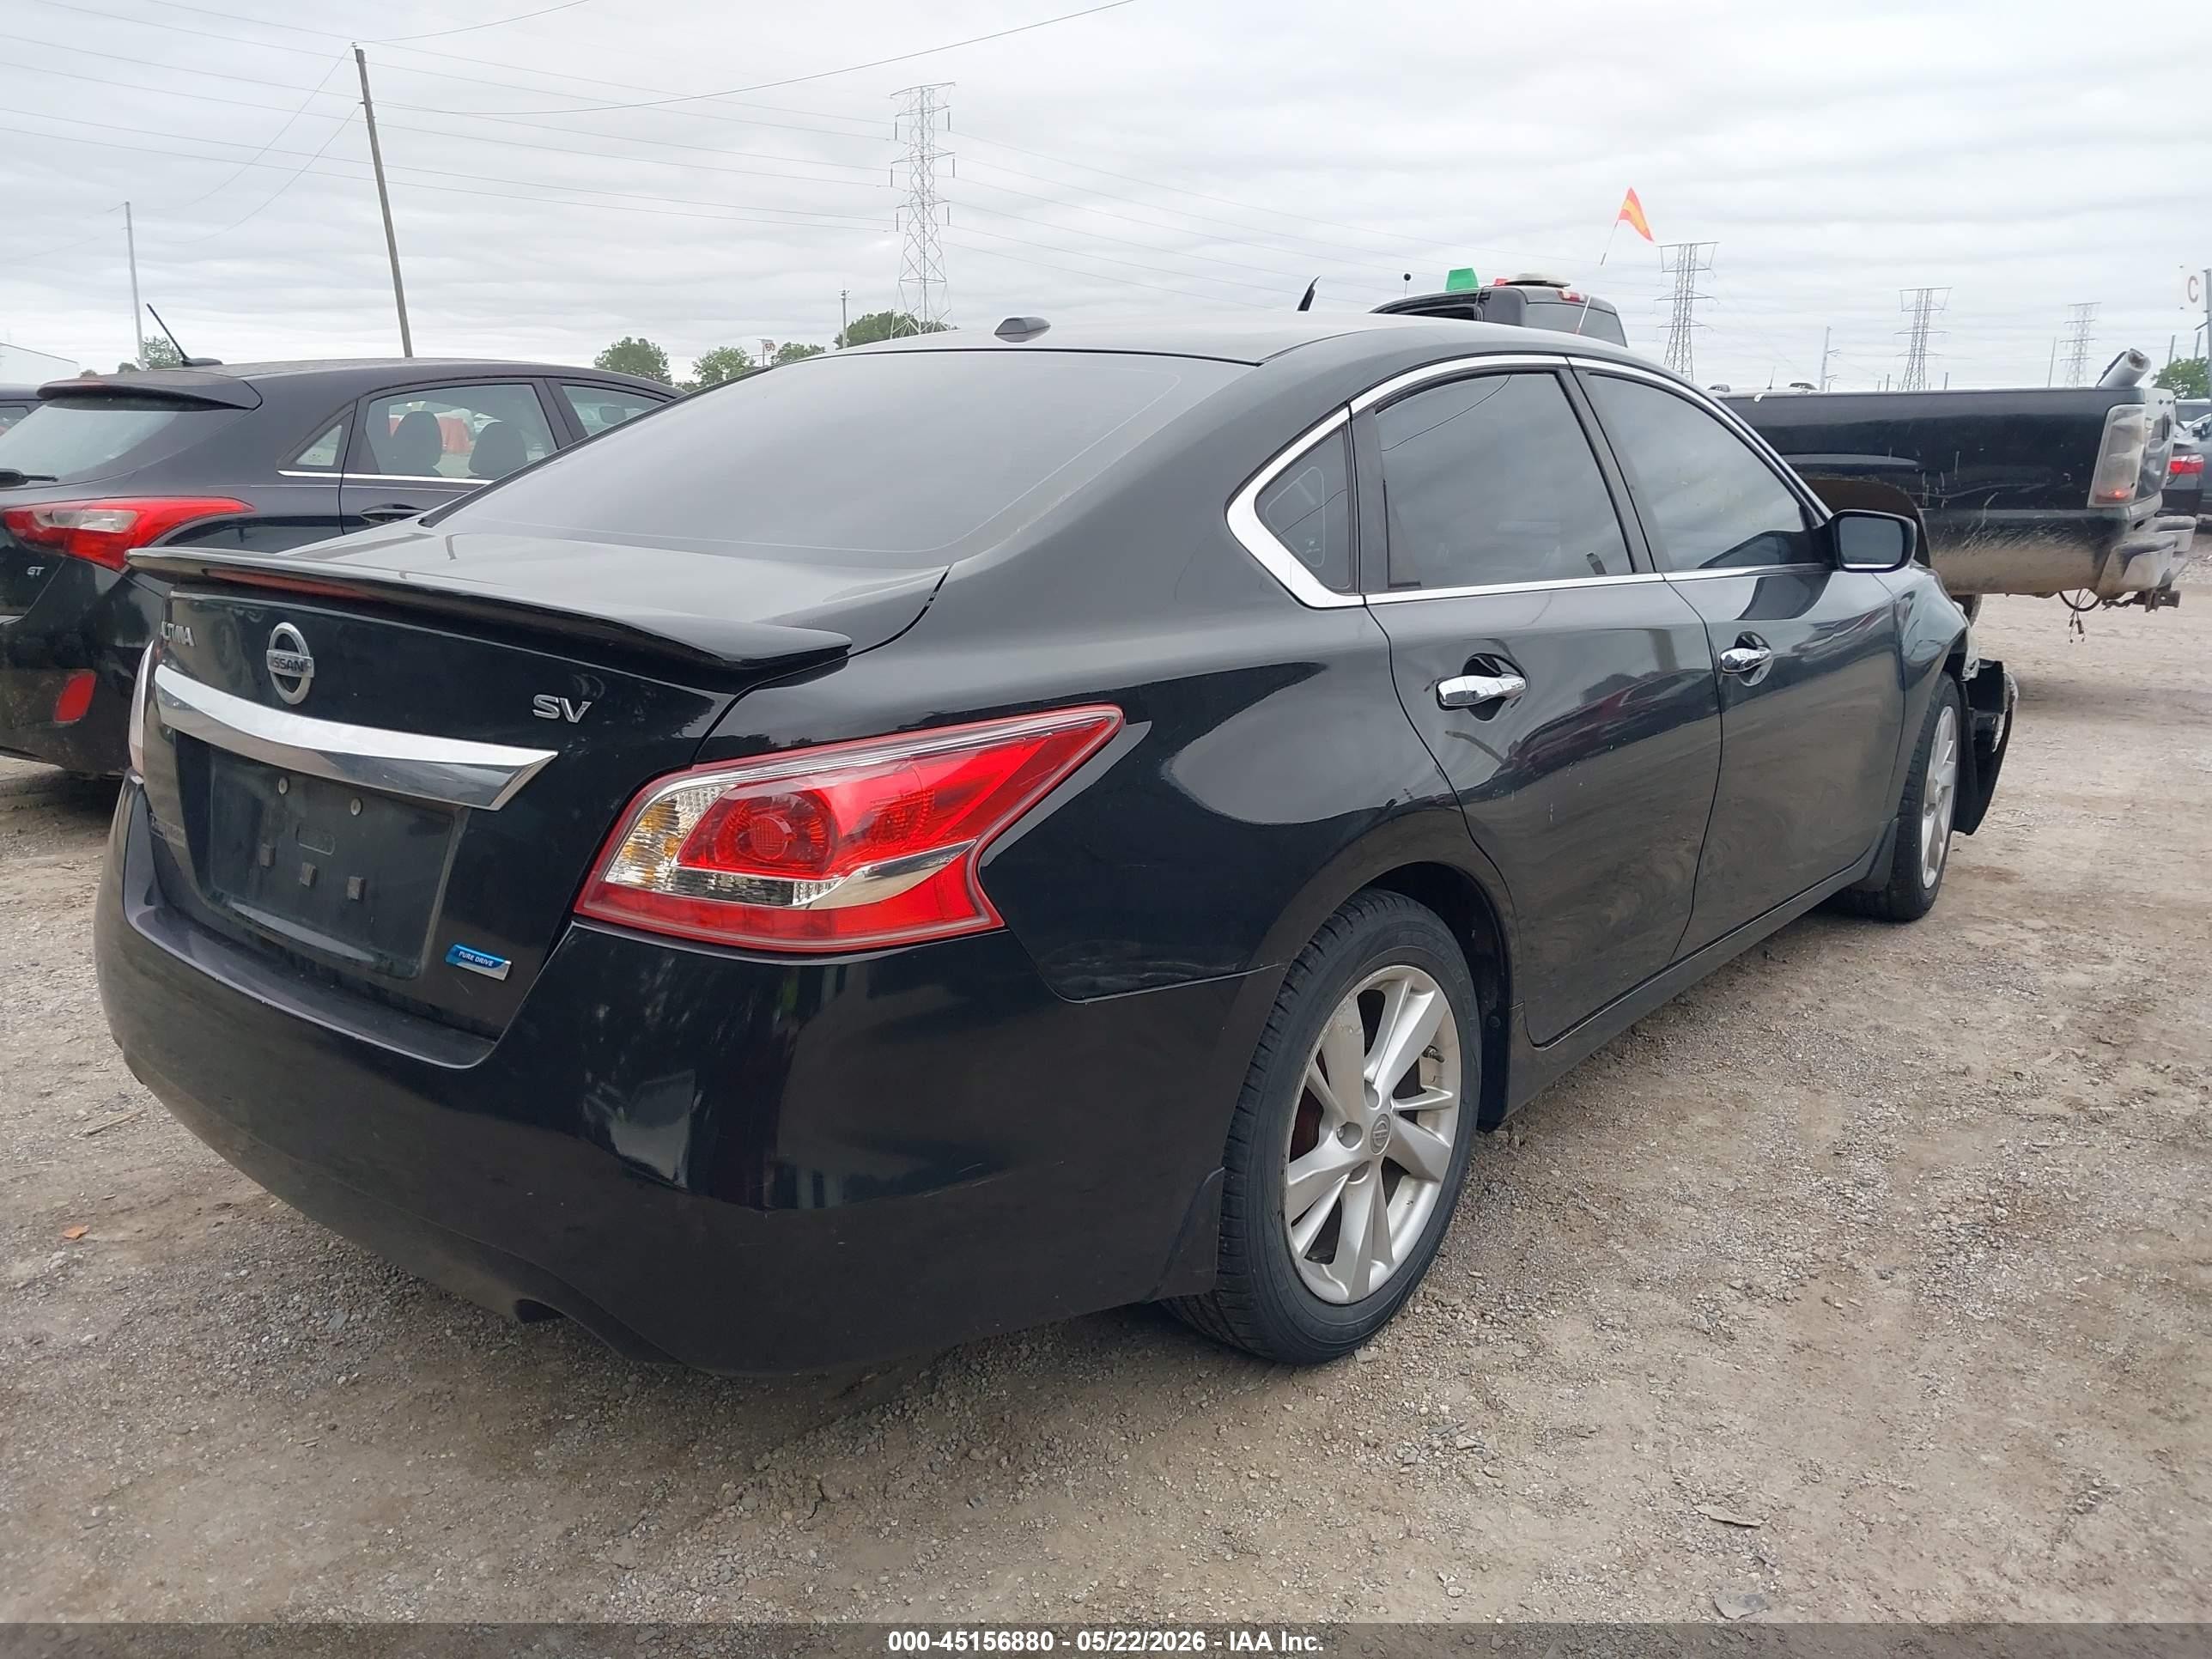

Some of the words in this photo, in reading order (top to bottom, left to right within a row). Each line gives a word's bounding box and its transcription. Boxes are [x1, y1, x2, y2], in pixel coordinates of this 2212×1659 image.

[2187, 275, 2199, 303] C
[27, 566, 46, 576] GT
[160, 621, 196, 647] LTIMA
[532, 694, 592, 723] SV
[459, 951, 474, 961] PURE
[475, 954, 495, 967] DRIVE
